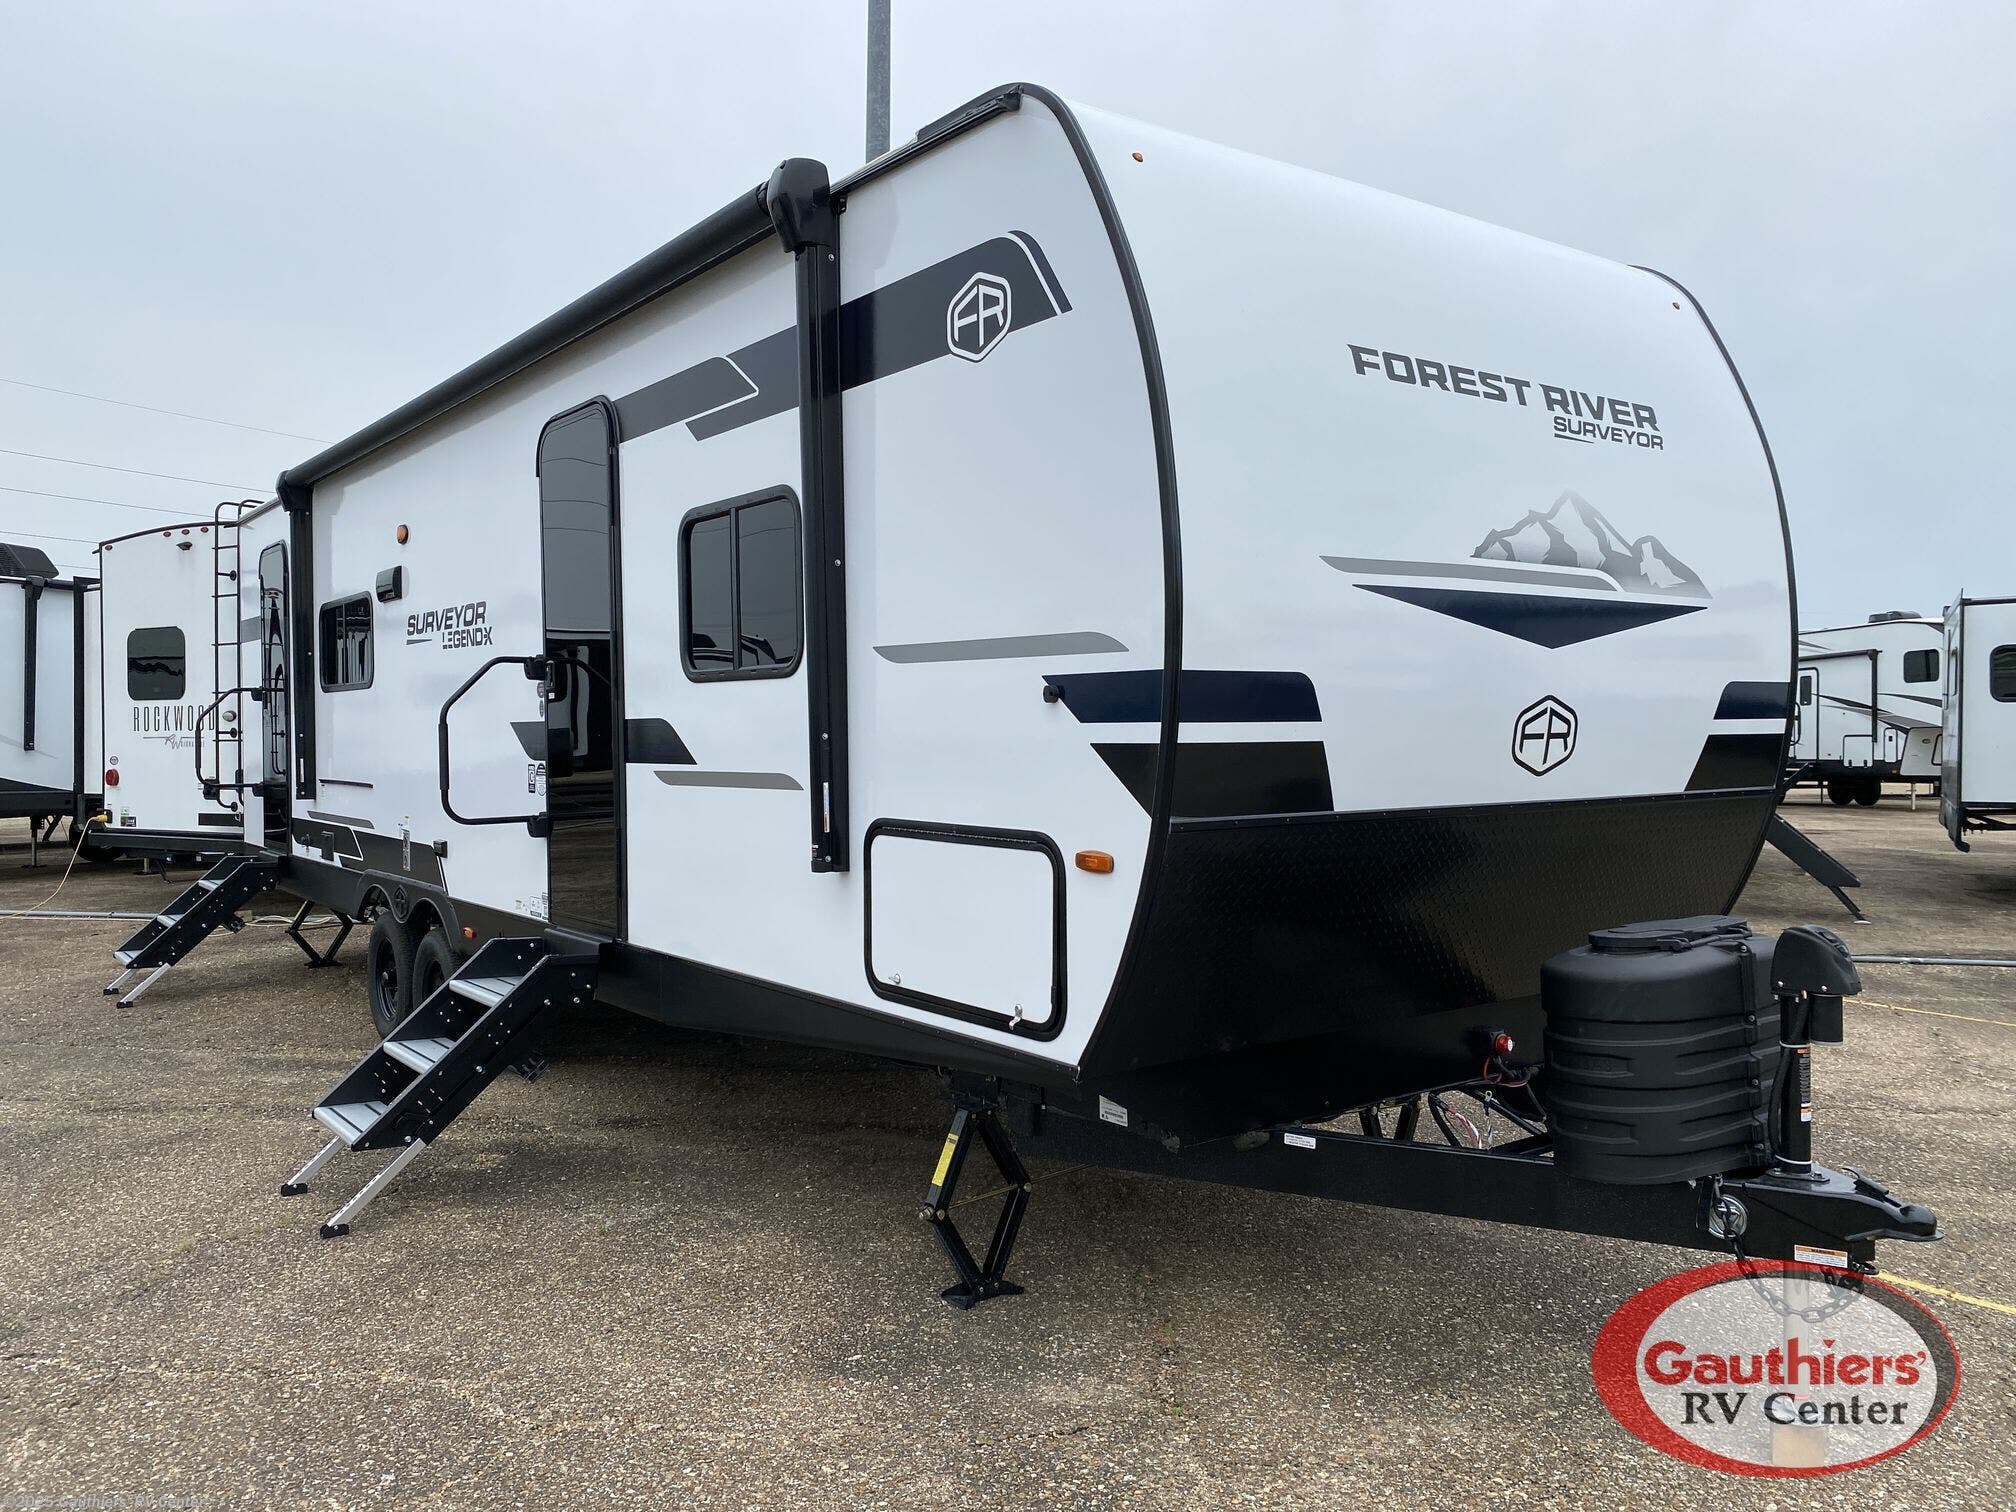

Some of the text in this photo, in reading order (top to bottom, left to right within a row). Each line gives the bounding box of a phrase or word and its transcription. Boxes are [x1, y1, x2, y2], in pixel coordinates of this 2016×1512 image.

[1346, 343, 1661, 432] FOREST RIVER
[1553, 415, 1665, 451] SURVEYOR
[406, 600, 488, 637] SURVEYOR
